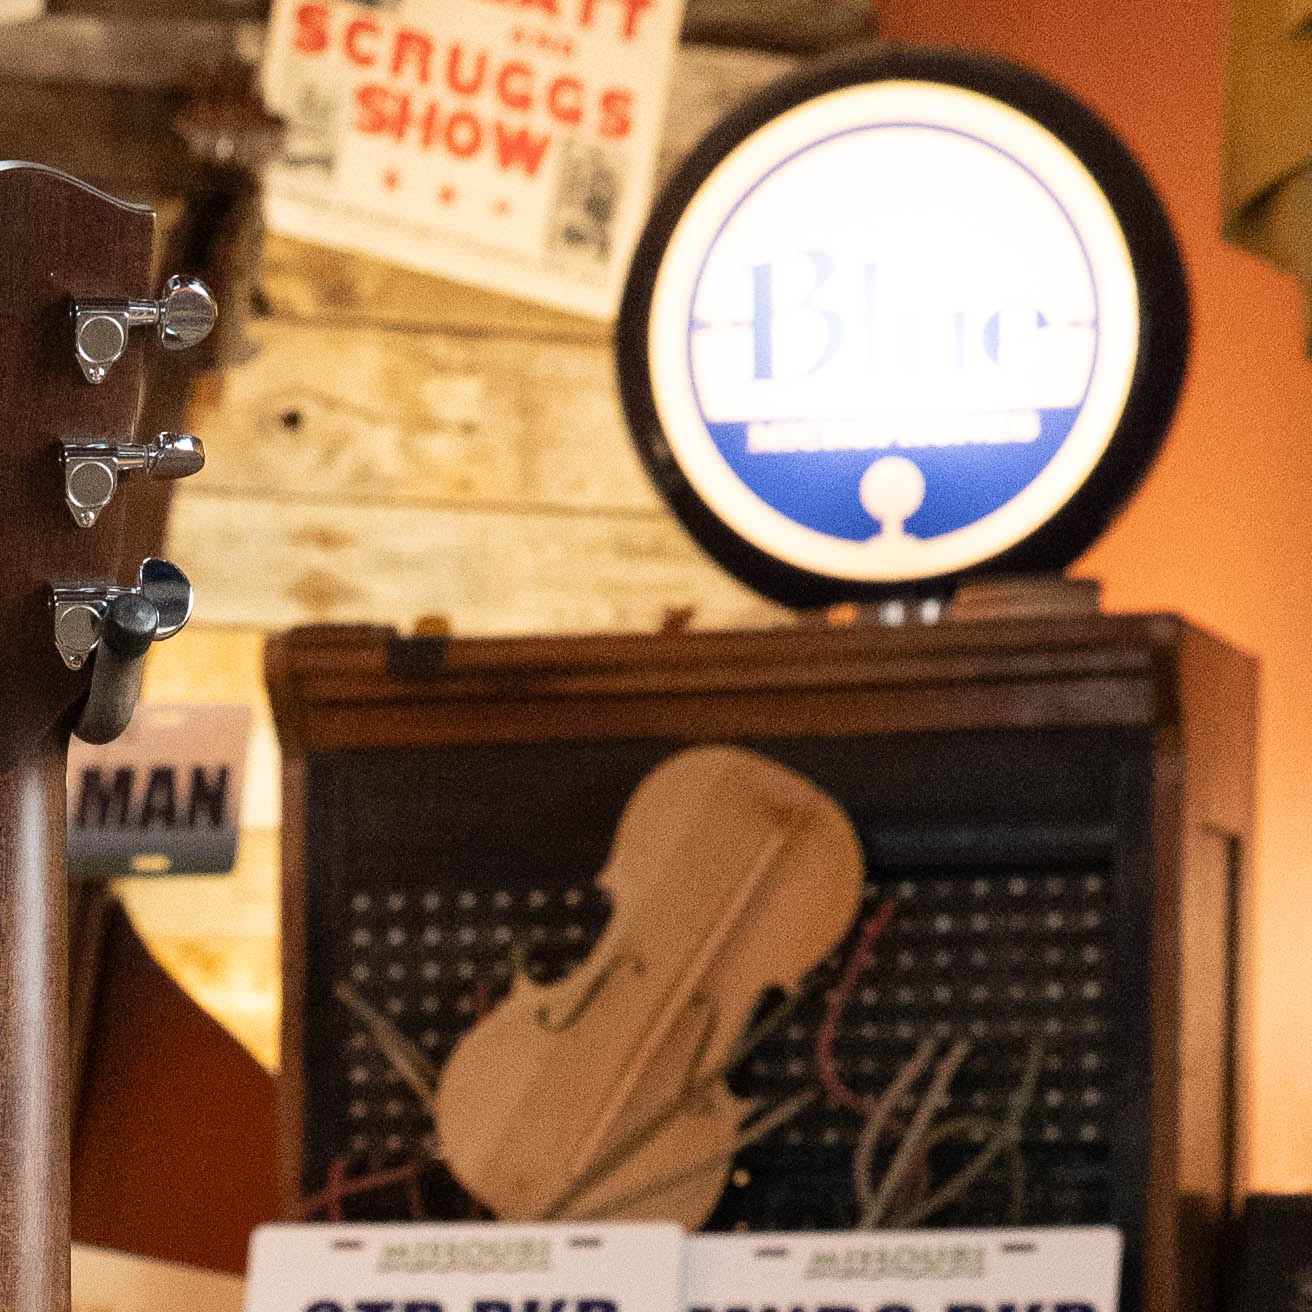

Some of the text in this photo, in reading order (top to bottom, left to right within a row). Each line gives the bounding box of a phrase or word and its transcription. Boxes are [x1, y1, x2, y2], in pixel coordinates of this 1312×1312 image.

[292, 2, 633, 140] SCRUGGS
[355, 83, 551, 178] SHOW
[751, 249, 1050, 381] Blue
